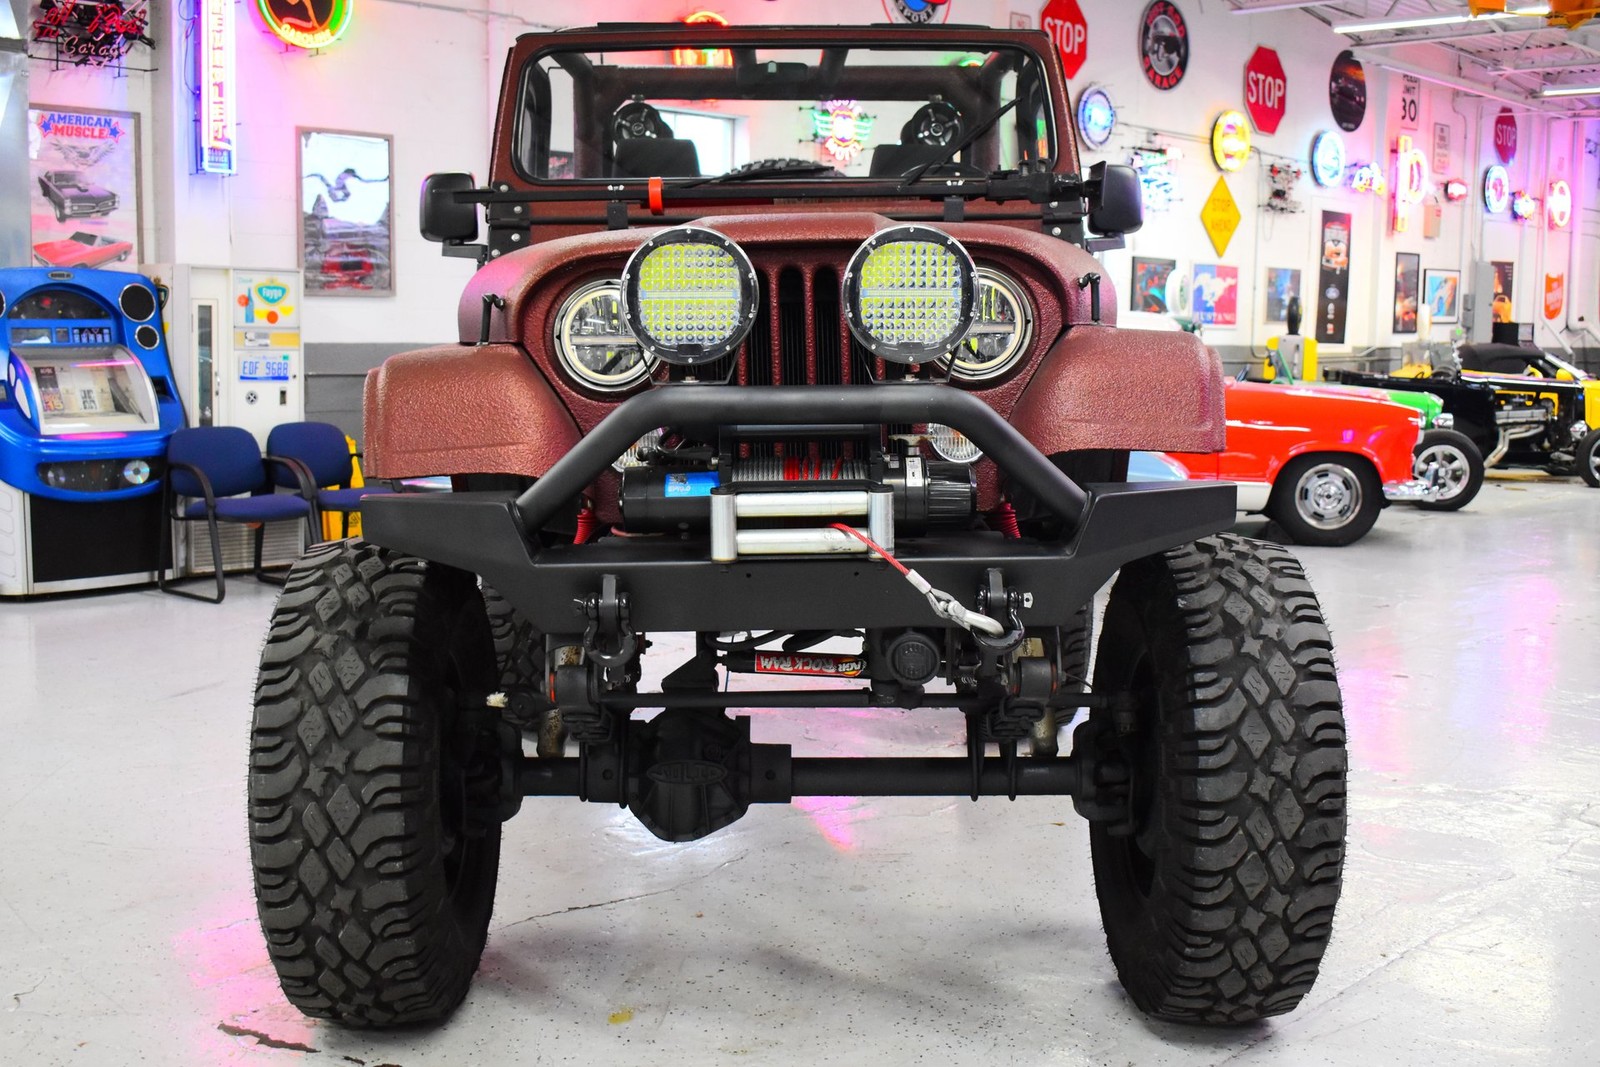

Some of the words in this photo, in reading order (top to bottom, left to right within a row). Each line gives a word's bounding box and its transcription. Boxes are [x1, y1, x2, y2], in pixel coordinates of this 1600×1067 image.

[1044, 16, 1086, 55] STOP
[1144, 54, 1184, 89] GARAGE
[1248, 70, 1285, 110] STOP
[1401, 97, 1417, 121] 30
[48, 113, 112, 128] AMERICAN
[54, 125, 105, 139] MUSCLE
[1496, 123, 1516, 148] STOP
[262, 287, 283, 300] Faygo
[760, 654, 795, 672] RAM
[793, 655, 836, 673] ROCK
[837, 661, 862, 673] AGR
